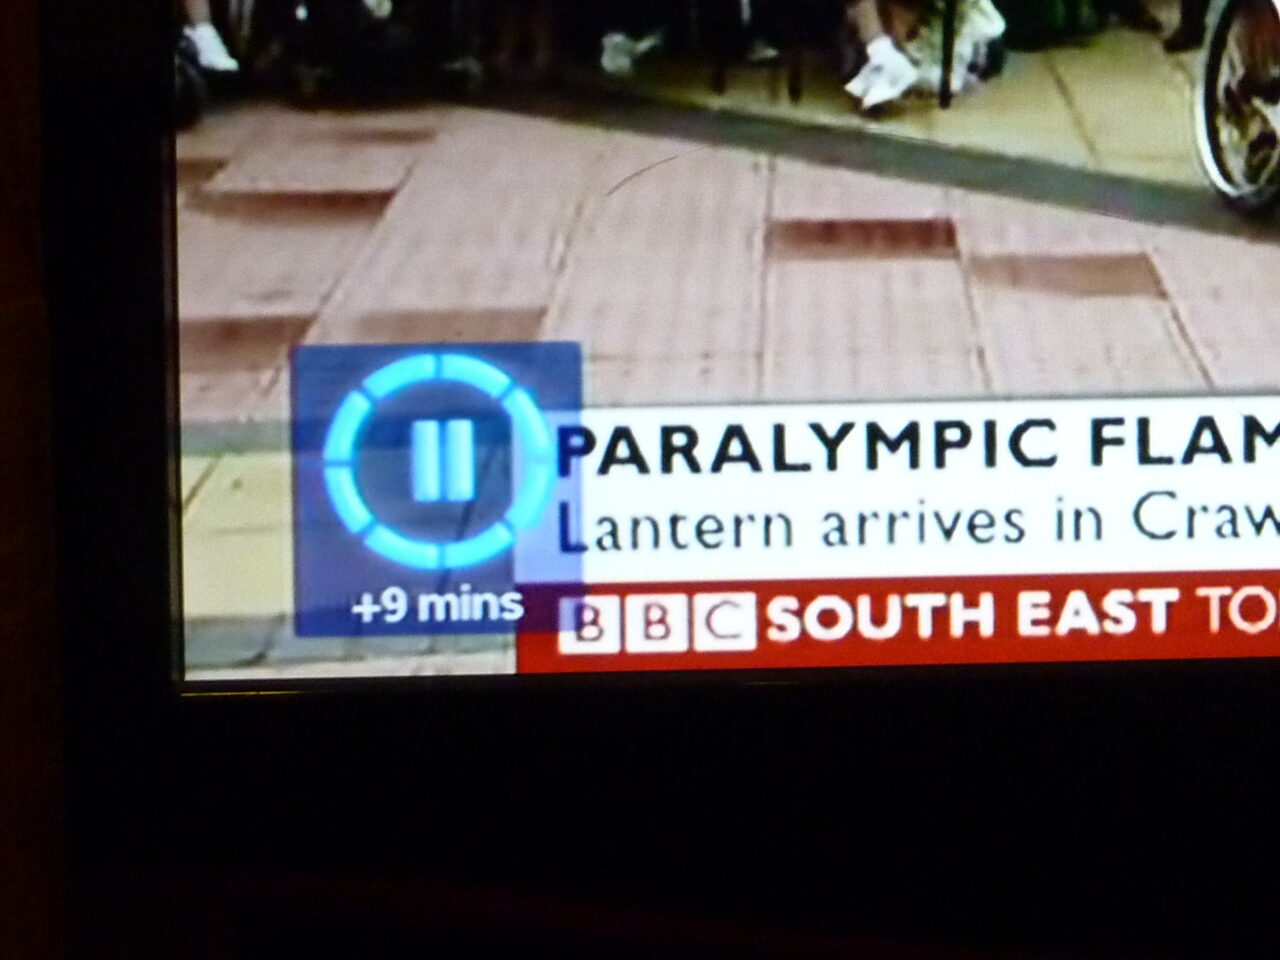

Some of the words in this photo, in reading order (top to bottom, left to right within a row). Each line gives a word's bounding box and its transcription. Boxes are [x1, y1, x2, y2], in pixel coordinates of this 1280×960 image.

[556, 417, 1058, 477] PARALYMPIC
[557, 502, 794, 554] Lantern
[822, 498, 1026, 547] arrives
[1056, 495, 1102, 541] in
[351, 585, 408, 625] +9
[418, 583, 524, 622] mins
[565, 596, 752, 648] BBC
[766, 591, 996, 642] SOUTH
[1016, 586, 1181, 637] EAST
